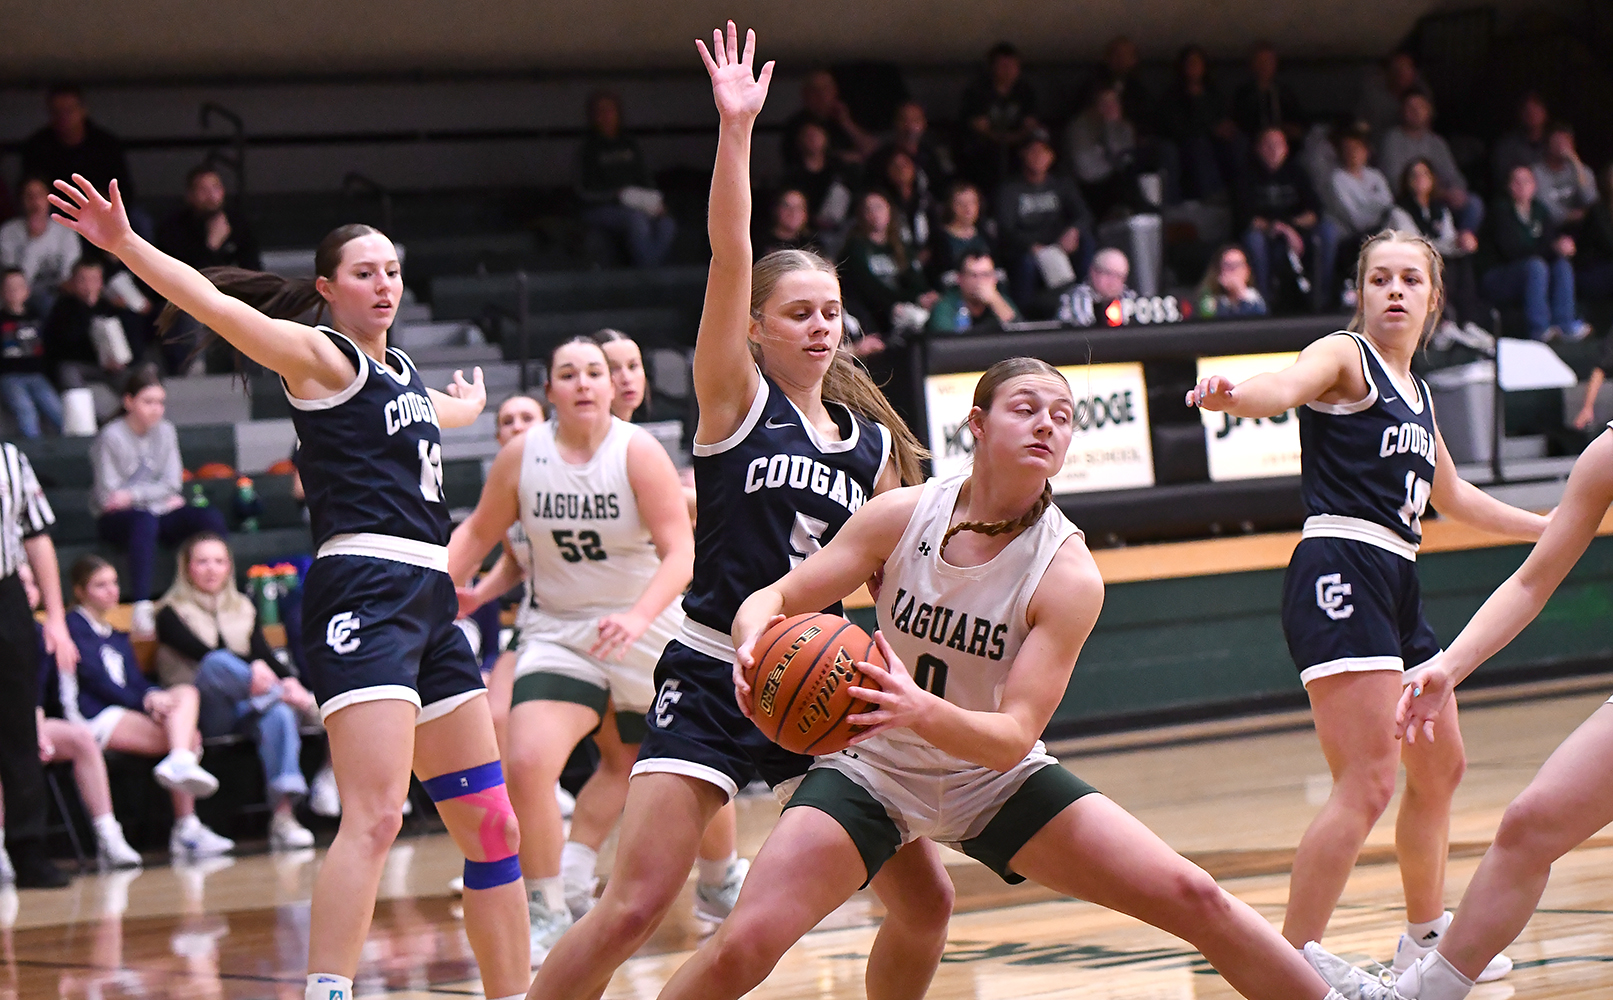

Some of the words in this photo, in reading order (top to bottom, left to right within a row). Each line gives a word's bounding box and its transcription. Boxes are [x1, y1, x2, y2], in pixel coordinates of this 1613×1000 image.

[533, 491, 620, 520] JAGUARS
[744, 453, 868, 515] COUGAR
[551, 529, 607, 563] 52
[788, 510, 830, 572] 5
[890, 587, 1008, 662] JAGUARS
[797, 646, 859, 735] Baden
